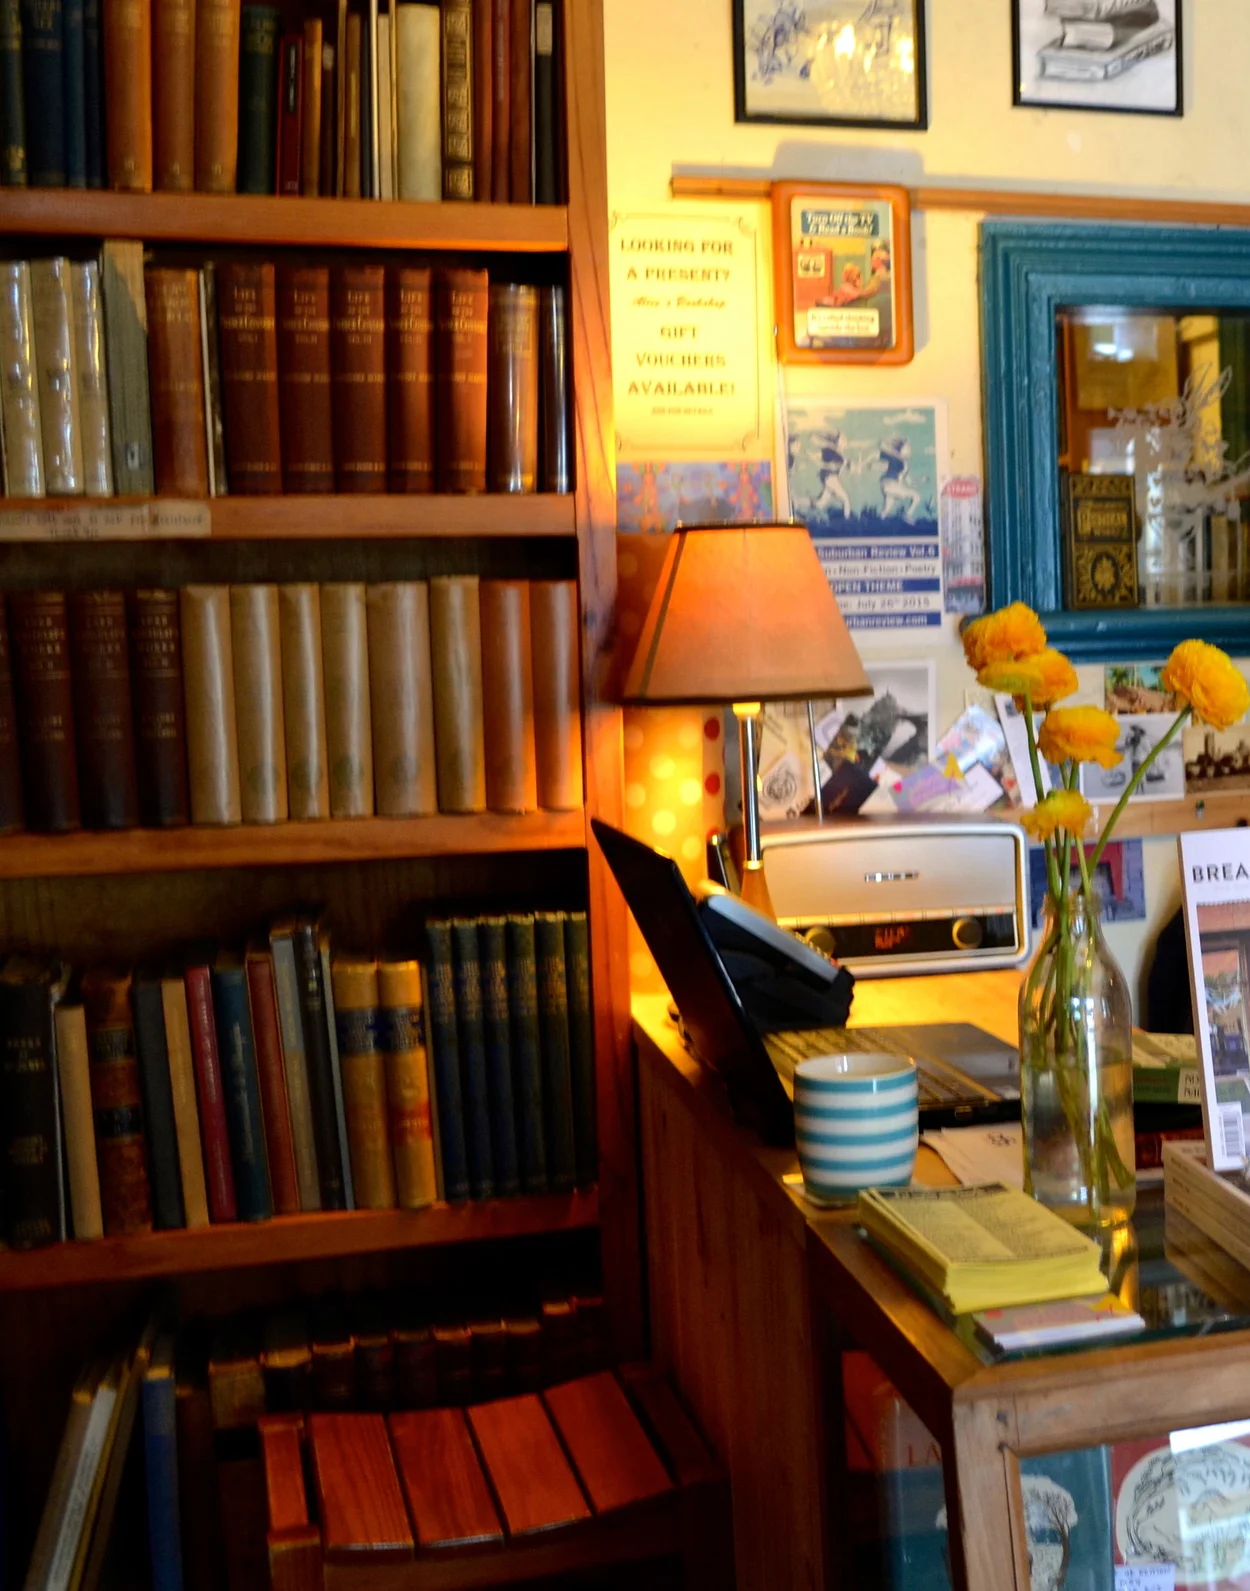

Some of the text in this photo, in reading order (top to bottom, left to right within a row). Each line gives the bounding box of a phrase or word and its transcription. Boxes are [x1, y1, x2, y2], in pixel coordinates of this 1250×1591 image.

[620, 239, 732, 255] LOOKING FOR
[627, 266, 638, 280] A
[660, 326, 696, 339] GIFT
[636, 352, 726, 368] VOUCHERS
[870, 547, 906, 559] Review
[866, 579, 901, 592] THEME
